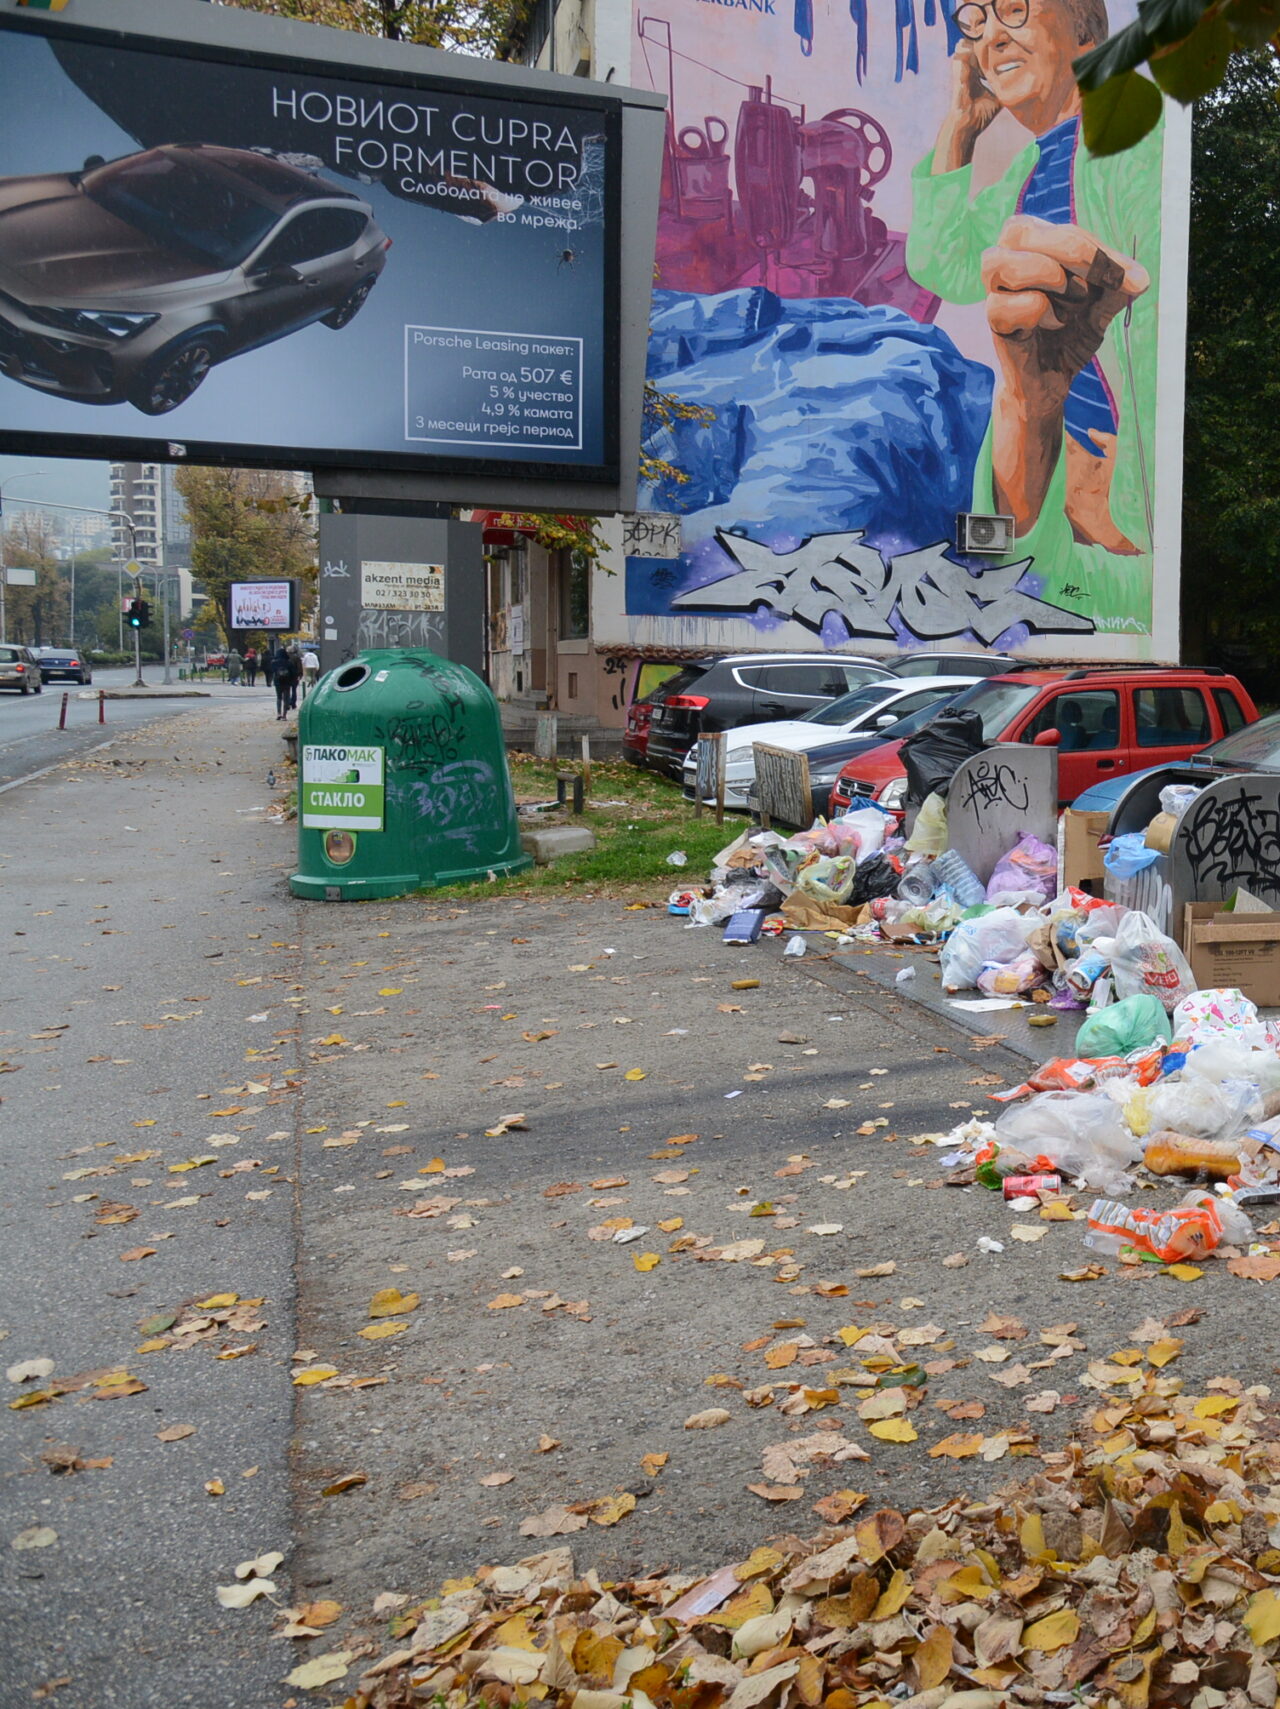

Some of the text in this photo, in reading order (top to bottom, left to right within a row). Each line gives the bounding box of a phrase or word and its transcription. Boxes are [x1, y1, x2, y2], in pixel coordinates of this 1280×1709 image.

[272, 86, 579, 154] НОВИОТ CUPRA
[335, 136, 577, 191] FORMENTOR
[400, 177, 500, 201] Слободата
[529, 195, 582, 211] живее
[497, 212, 583, 230] во мрежа.
[414, 331, 574, 356] Porsche Leasing пакет:
[462, 366, 573, 385] Рата од 507 €
[489, 385, 573, 402] 5 % учество
[481, 402, 573, 419] 4,9 % камата
[415, 416, 574, 439] 3 месеци грејс период
[365, 573, 441, 585] akzent media
[375, 589, 386, 597] 02
[392, 590, 407, 598] 323
[409, 590, 419, 598] 30
[313, 748, 377, 762] ПАКОМАК
[310, 791, 365, 808] СТАКЛО
